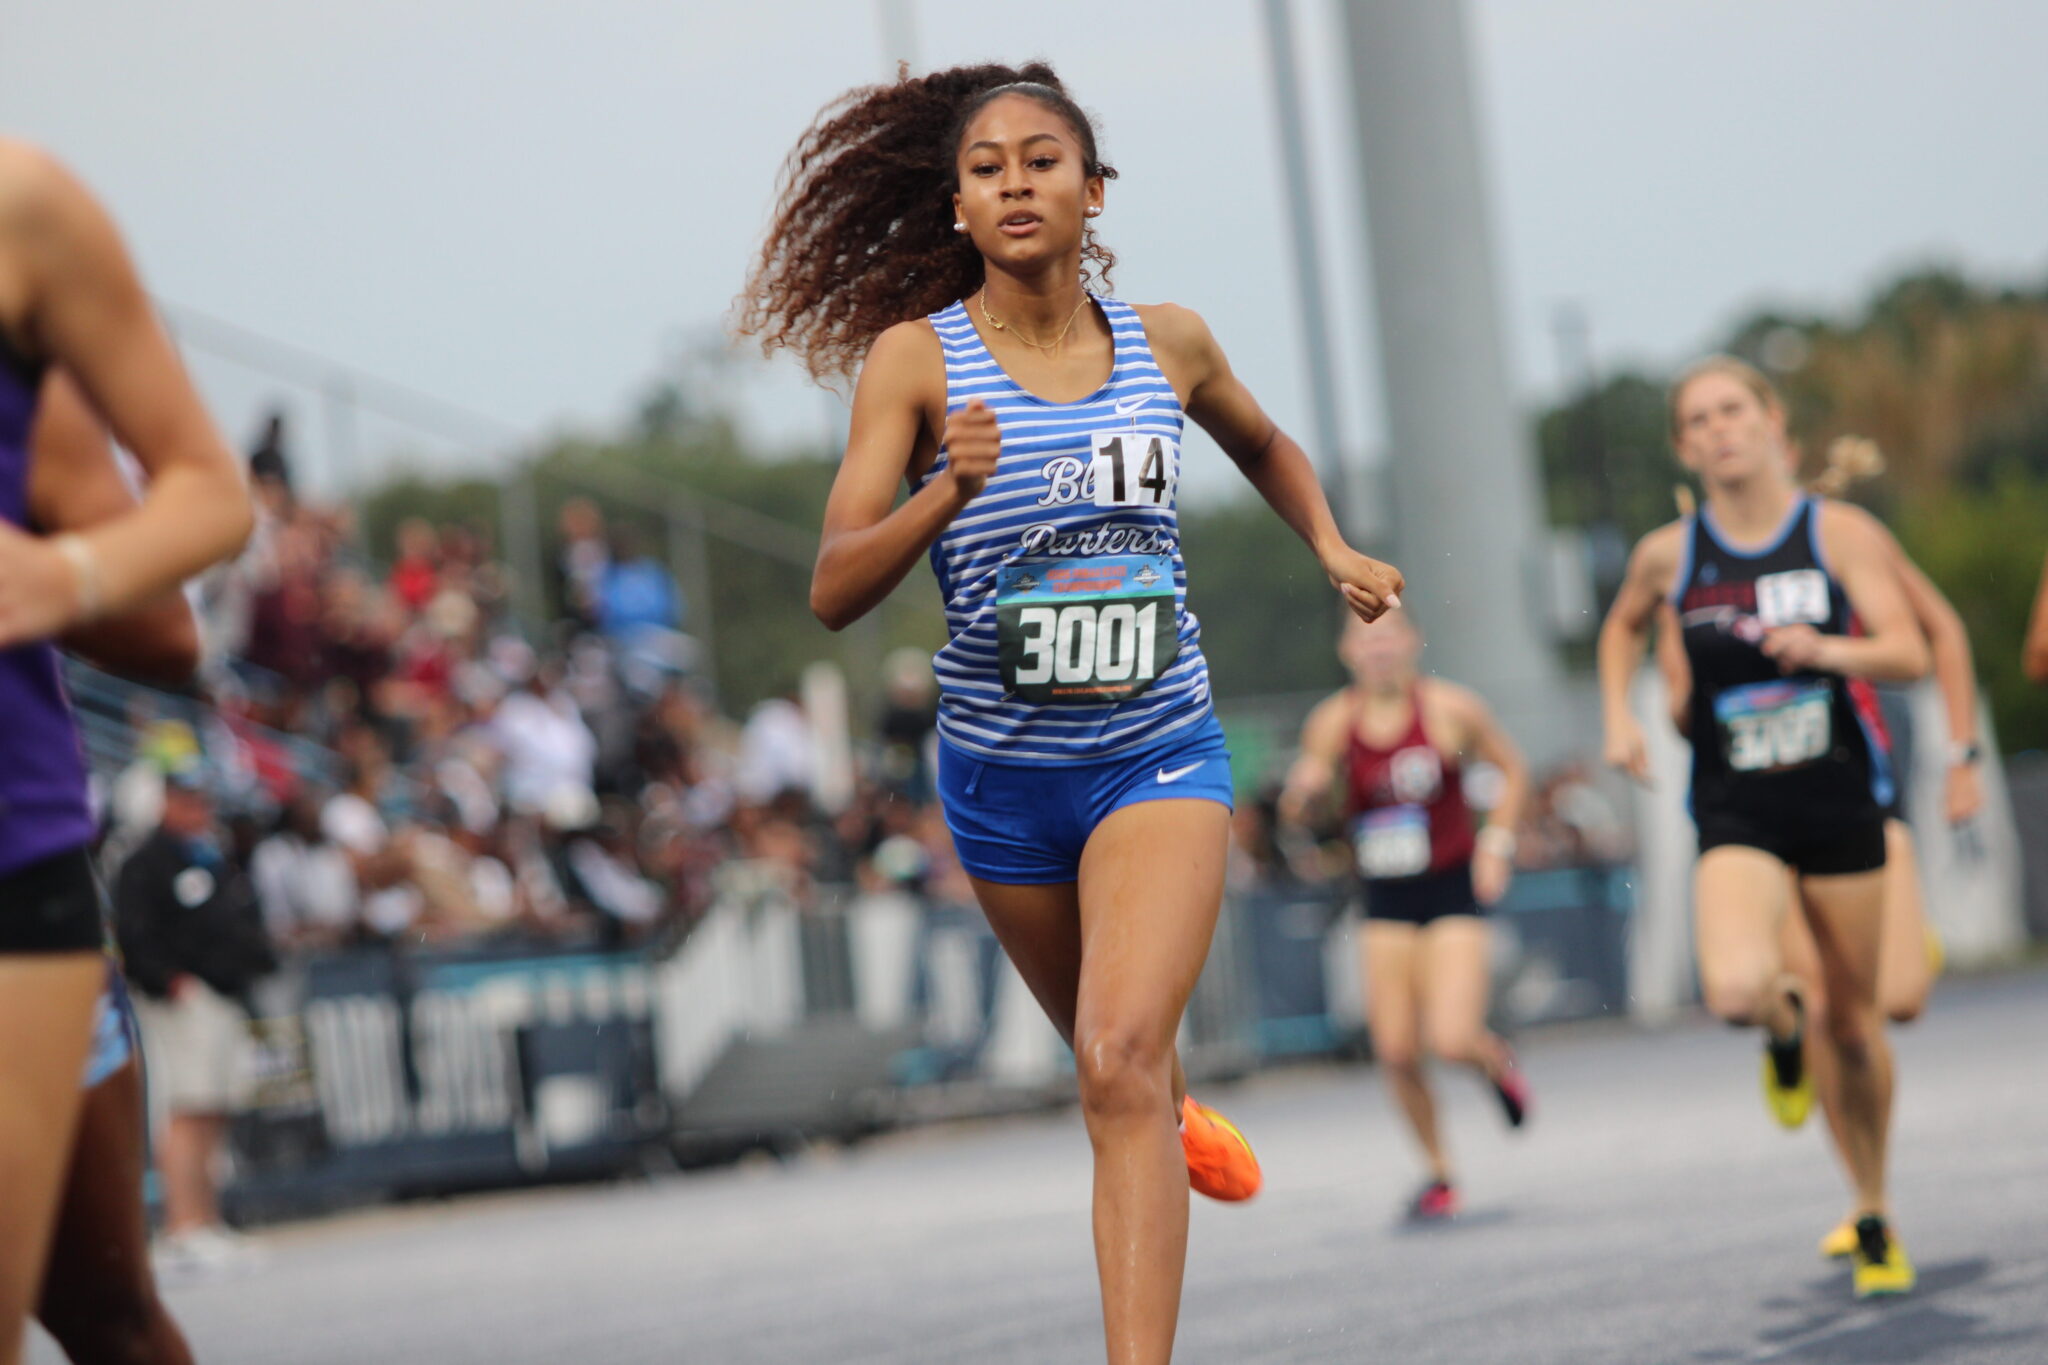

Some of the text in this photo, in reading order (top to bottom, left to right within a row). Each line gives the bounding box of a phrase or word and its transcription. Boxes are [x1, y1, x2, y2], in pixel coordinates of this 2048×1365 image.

[1037, 455, 1096, 507] Bl
[1098, 436, 1167, 504] 14
[1020, 520, 1169, 558] Darters
[1015, 601, 1158, 685] 3001
